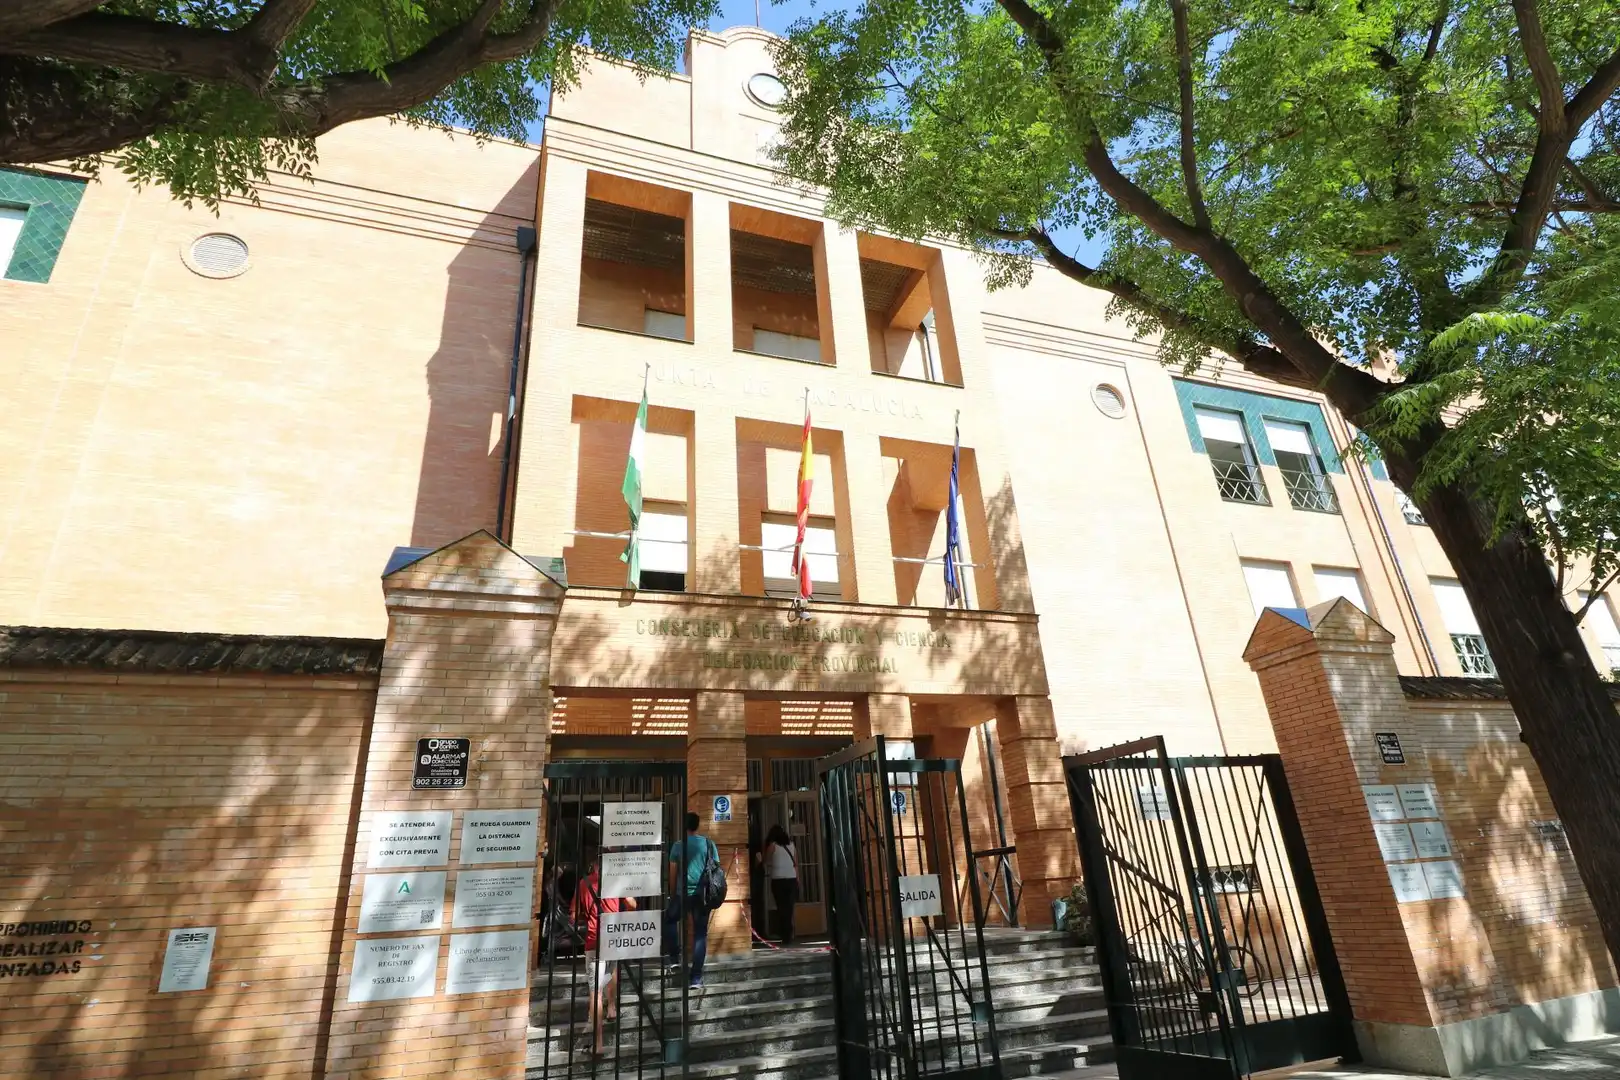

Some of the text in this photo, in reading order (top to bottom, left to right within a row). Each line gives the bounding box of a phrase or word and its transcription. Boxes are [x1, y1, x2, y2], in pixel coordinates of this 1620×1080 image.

[752, 622, 771, 640] DE
[895, 631, 951, 648] CIENCIA
[812, 655, 900, 674] PROVINCIAL
[415, 778, 430, 786] 902
[379, 834, 442, 842] EXCLUSIVAMENTE
[899, 890, 936, 902] SALIDA
[606, 921, 657, 934] ENTRADA
[0, 940, 84, 957] EALIZAR
[608, 936, 655, 949] PÚBLICO
[0, 960, 81, 978] NTADAS
[378, 959, 414, 968] REGISTRO
